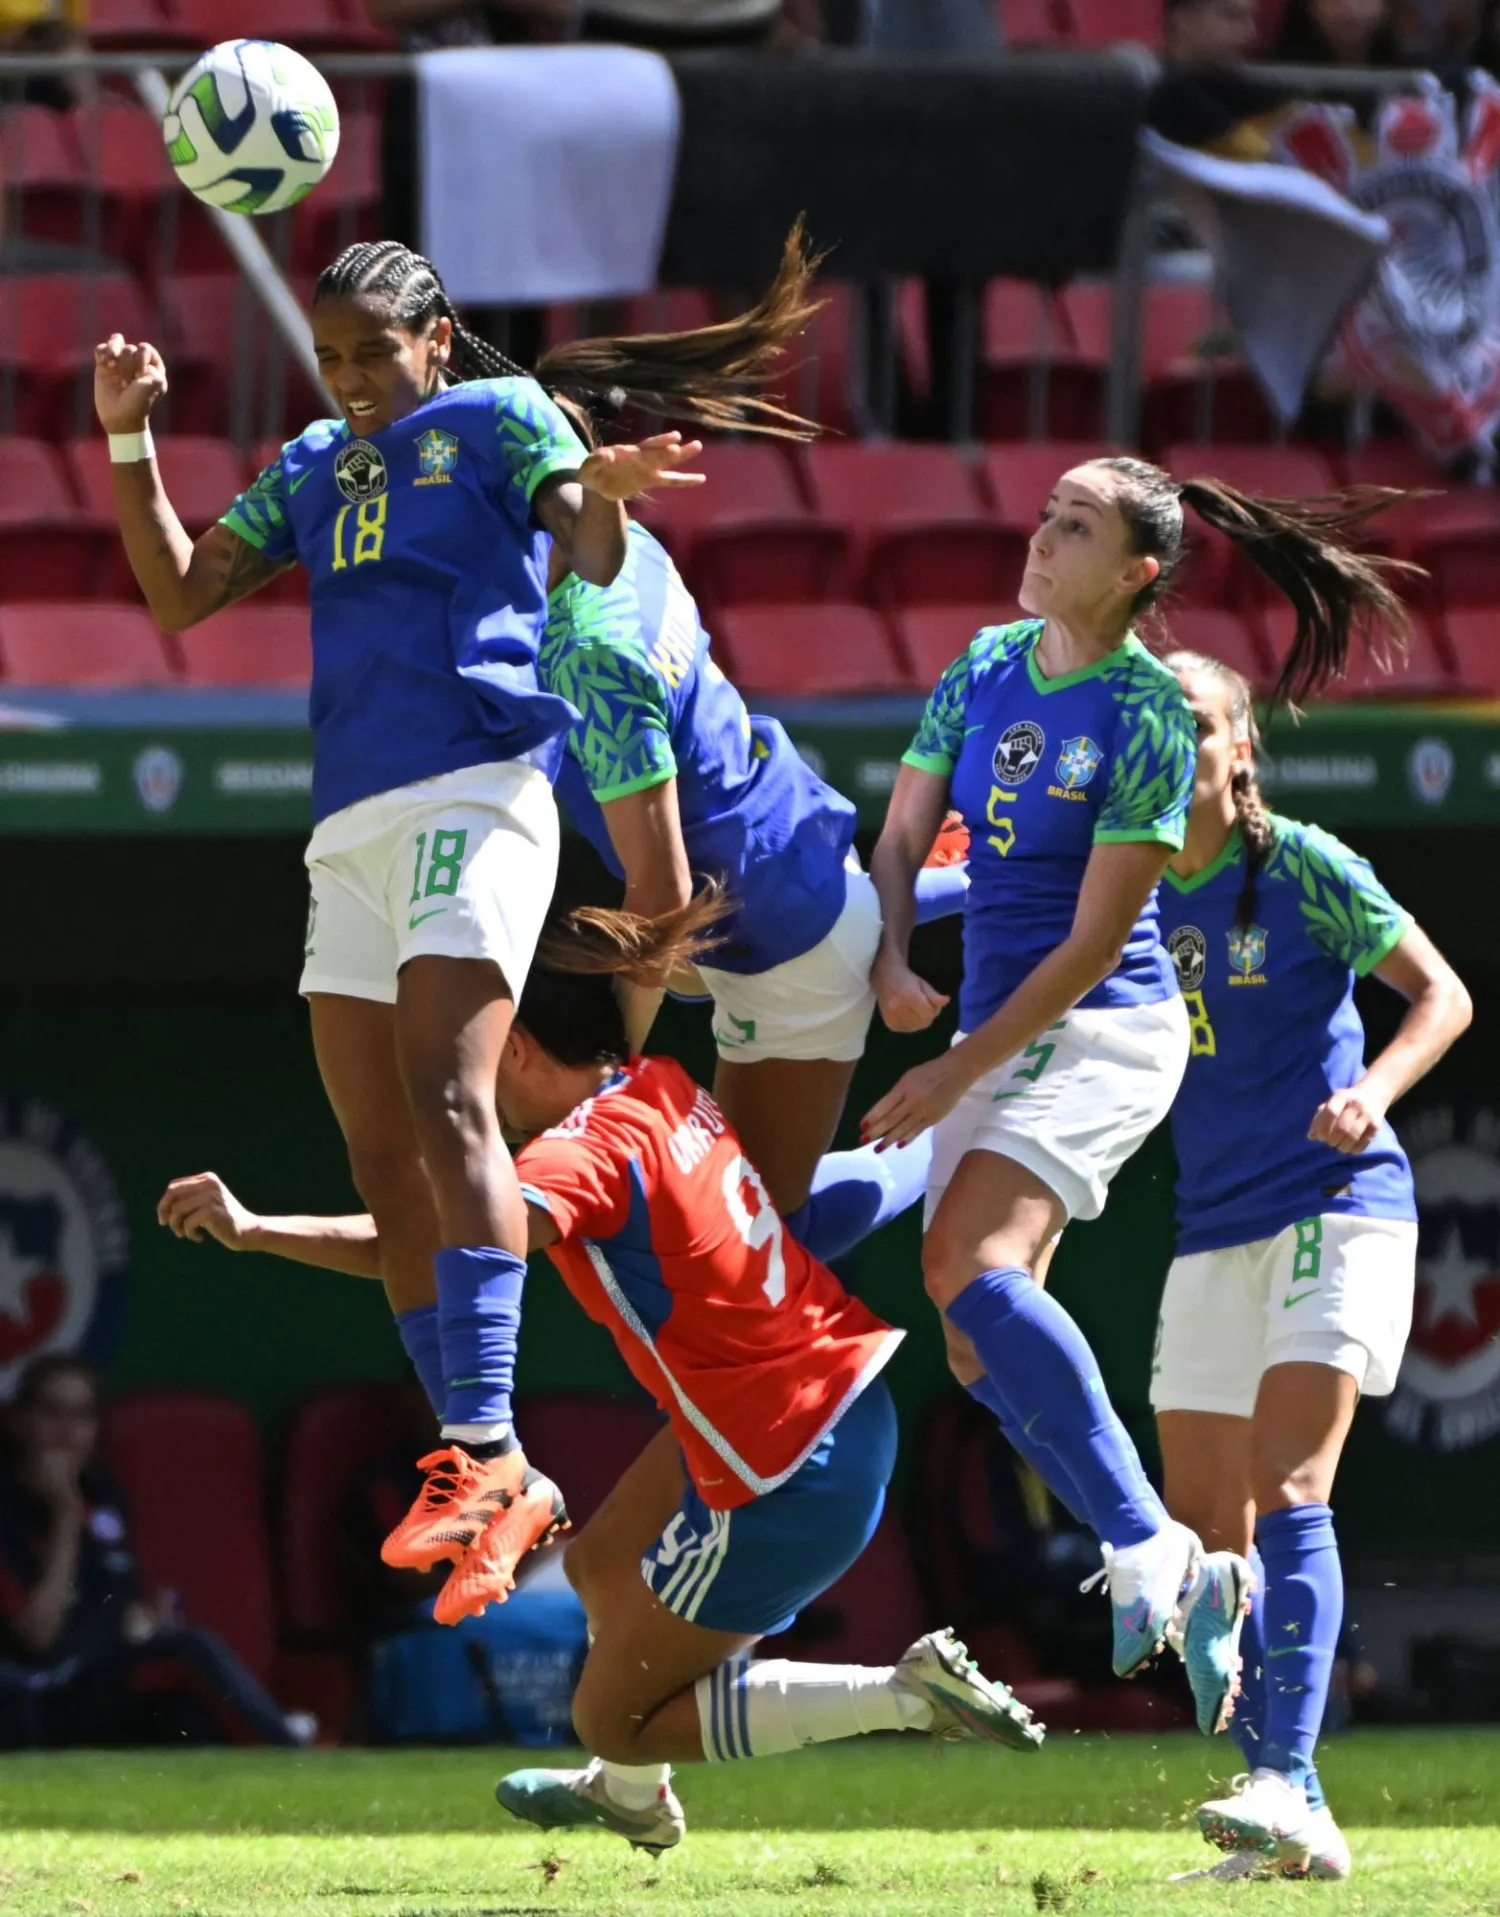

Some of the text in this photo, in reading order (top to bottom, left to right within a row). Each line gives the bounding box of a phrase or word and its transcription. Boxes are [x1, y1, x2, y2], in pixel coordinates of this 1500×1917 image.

[412, 474, 453, 487] BRASIL
[331, 492, 390, 572] 18
[986, 784, 1018, 857] 5
[1047, 785, 1088, 801] BRASIL
[409, 829, 468, 906] 18
[1228, 974, 1268, 985] BRASIL
[1011, 1020, 1068, 1082] 5
[1181, 990, 1216, 1056] 8
[722, 1153, 787, 1308] 9
[1292, 1216, 1322, 1283] 8
